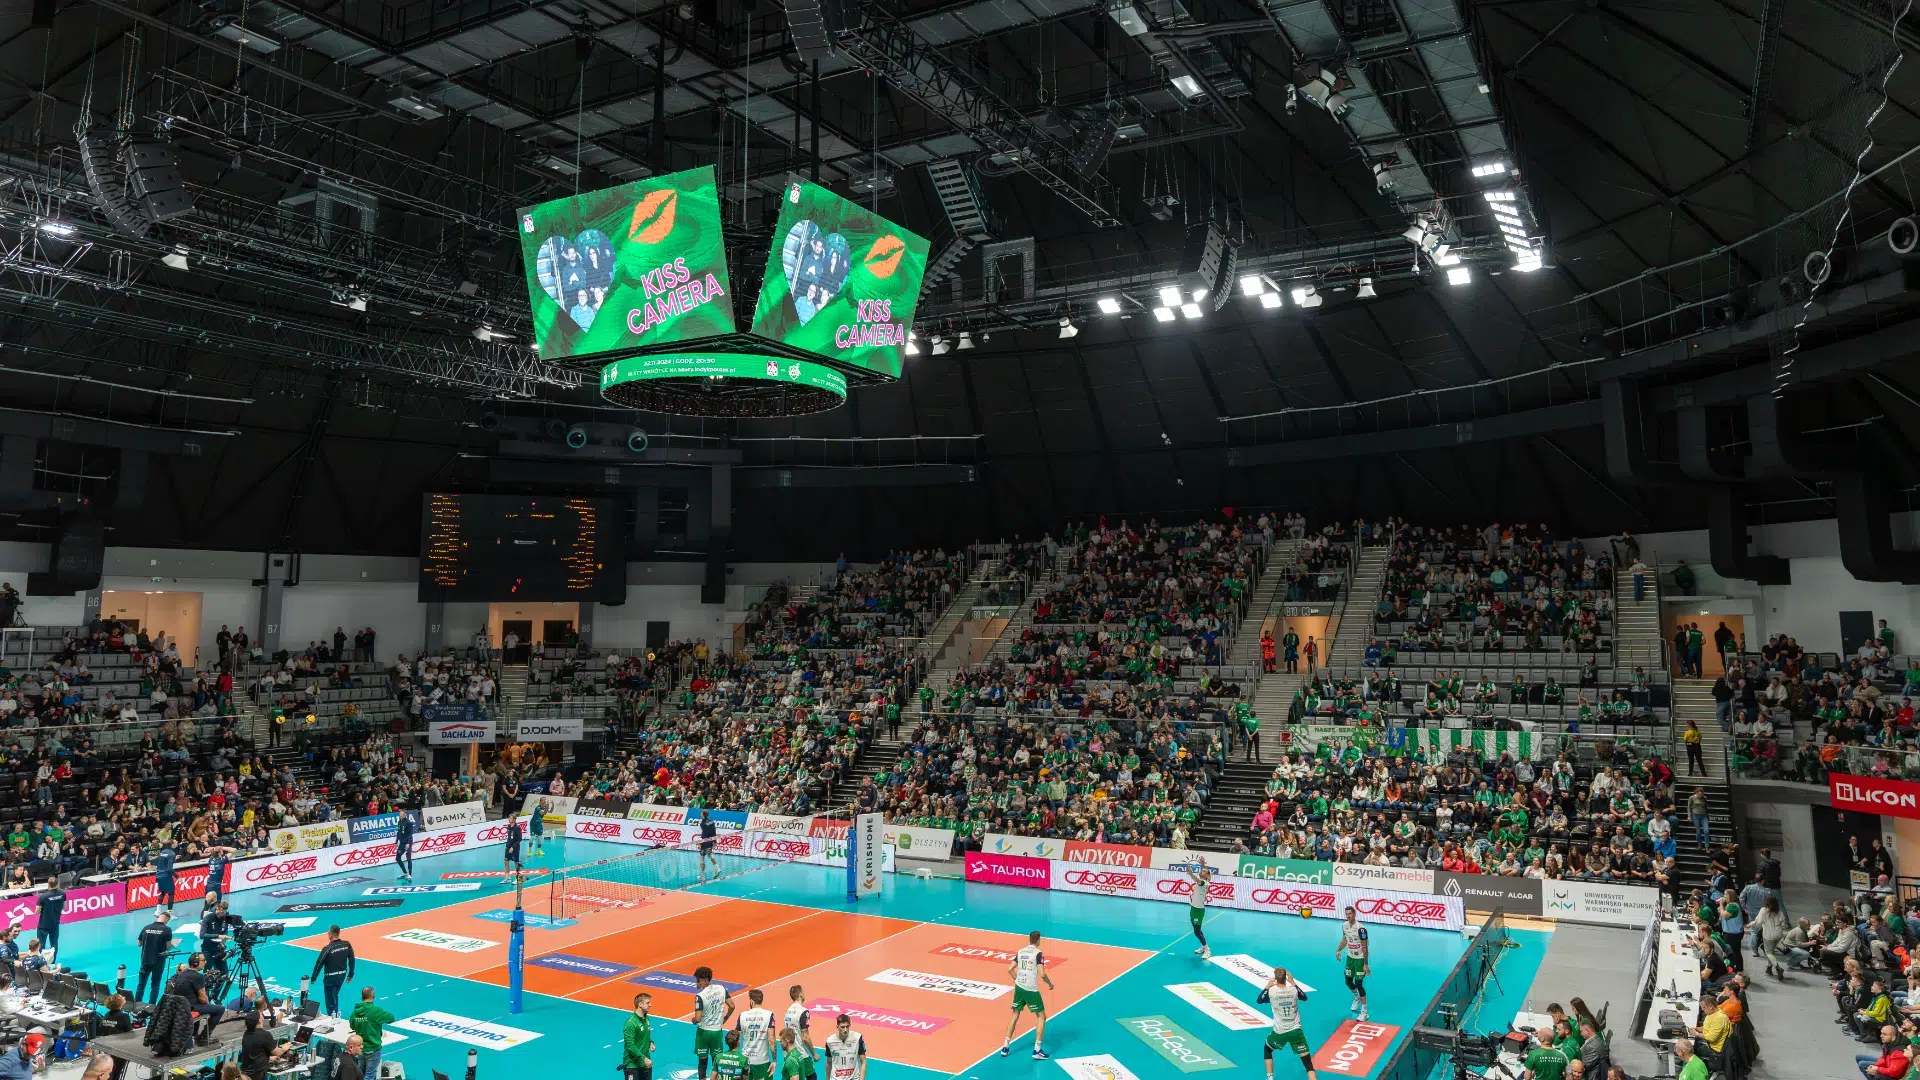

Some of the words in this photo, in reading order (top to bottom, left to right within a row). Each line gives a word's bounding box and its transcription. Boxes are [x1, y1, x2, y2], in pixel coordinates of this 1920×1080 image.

[640, 257, 690, 299] KISS
[627, 273, 725, 334] CAMERA
[857, 299, 891, 323] KISS
[835, 323, 905, 349] CAMERA
[88, 597, 99, 607] B6
[268, 624, 278, 635] B7
[441, 729, 485, 739] DACHLAND
[353, 813, 416, 833] ARMATUA
[752, 816, 804, 831] livingroom
[866, 817, 874, 877] KRISHOME
[914, 838, 949, 848] OLSZTYN
[990, 864, 1046, 879] TAURON
[1347, 867, 1433, 883] szynakameble
[1465, 887, 1504, 898] RENAULT
[1584, 891, 1625, 901] UNIWERSYTET
[1592, 906, 1623, 915] OLSZTYNIE
[391, 931, 454, 945] plus
[892, 970, 998, 993] livingroom
[844, 1009, 936, 1030] TAURON
[409, 1017, 507, 1042] castorama
